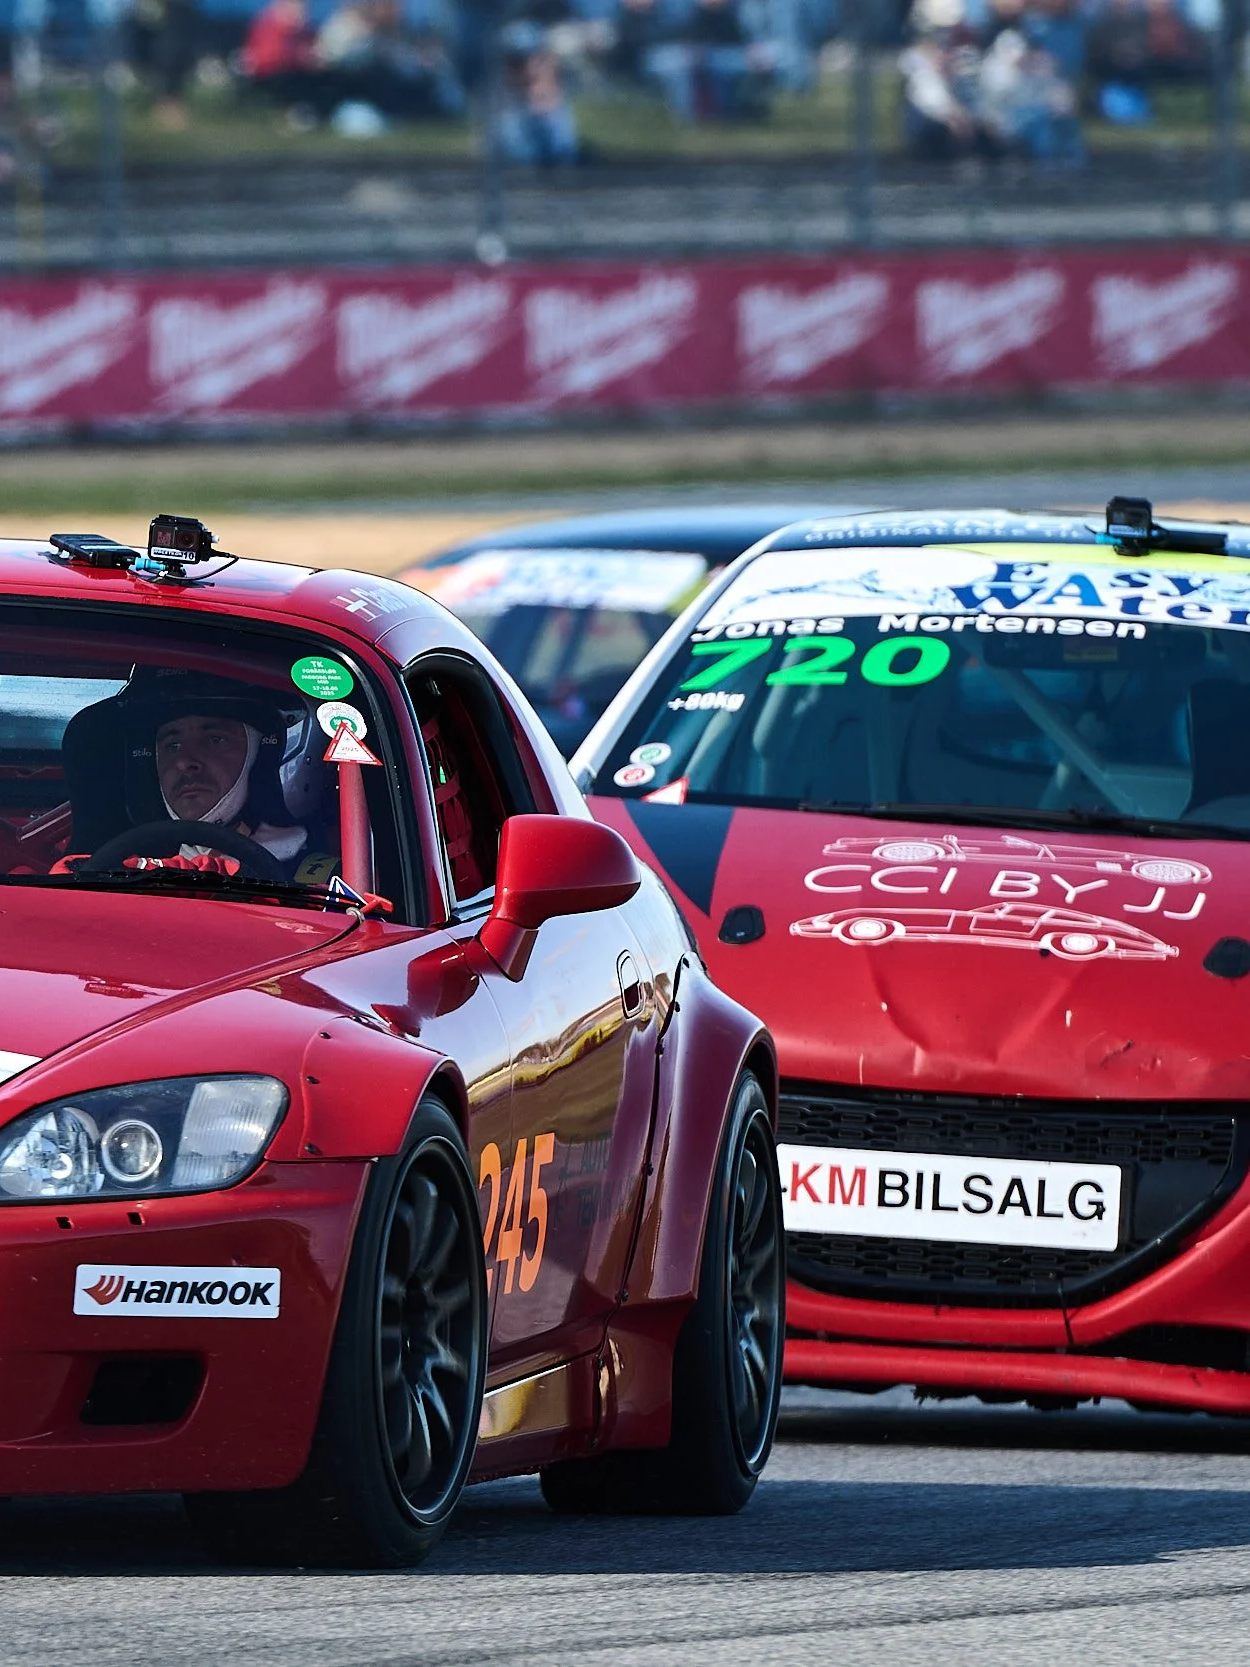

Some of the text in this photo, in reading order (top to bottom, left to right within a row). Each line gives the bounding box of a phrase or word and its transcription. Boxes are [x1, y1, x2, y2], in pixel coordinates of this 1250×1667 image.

[690, 613, 1148, 642] Jonas Mortensen
[680, 635, 951, 692] 720
[803, 863, 1207, 921] CCI BY JJ
[477, 1132, 556, 1298] 245
[877, 1169, 1106, 1221] BILSALG
